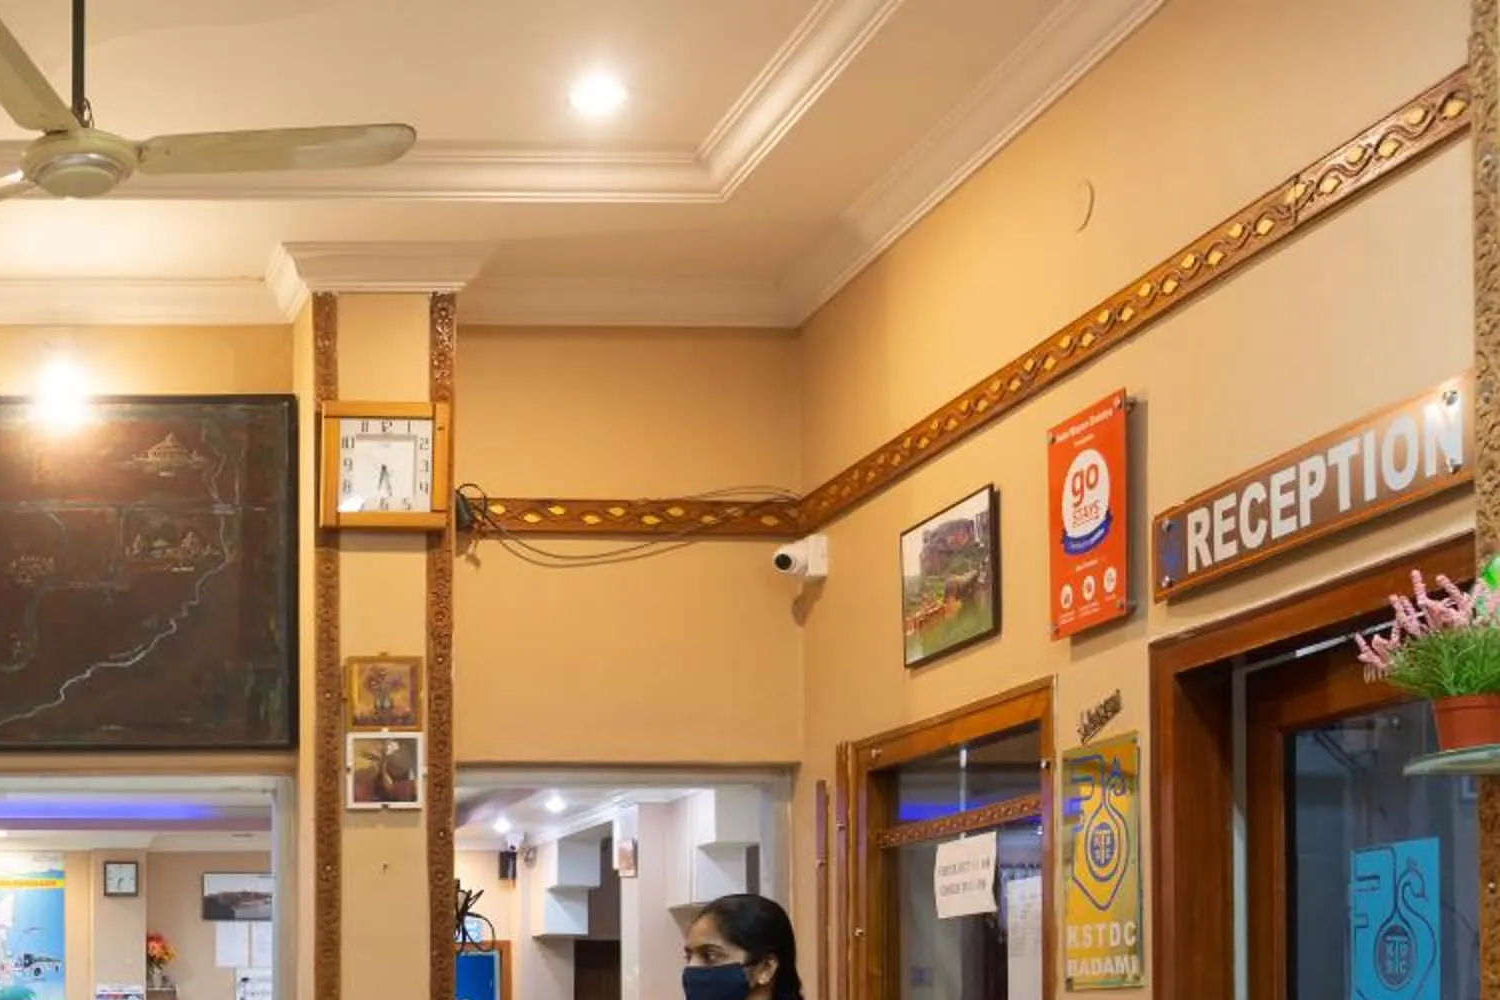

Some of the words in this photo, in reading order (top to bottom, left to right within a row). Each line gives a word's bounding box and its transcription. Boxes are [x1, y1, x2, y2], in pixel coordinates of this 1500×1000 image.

[1072, 463, 1100, 507] go
[1186, 392, 1464, 574] RECEPTION
[1066, 920, 1138, 950] KSTDC
[1067, 949, 1139, 977] BADAMI
